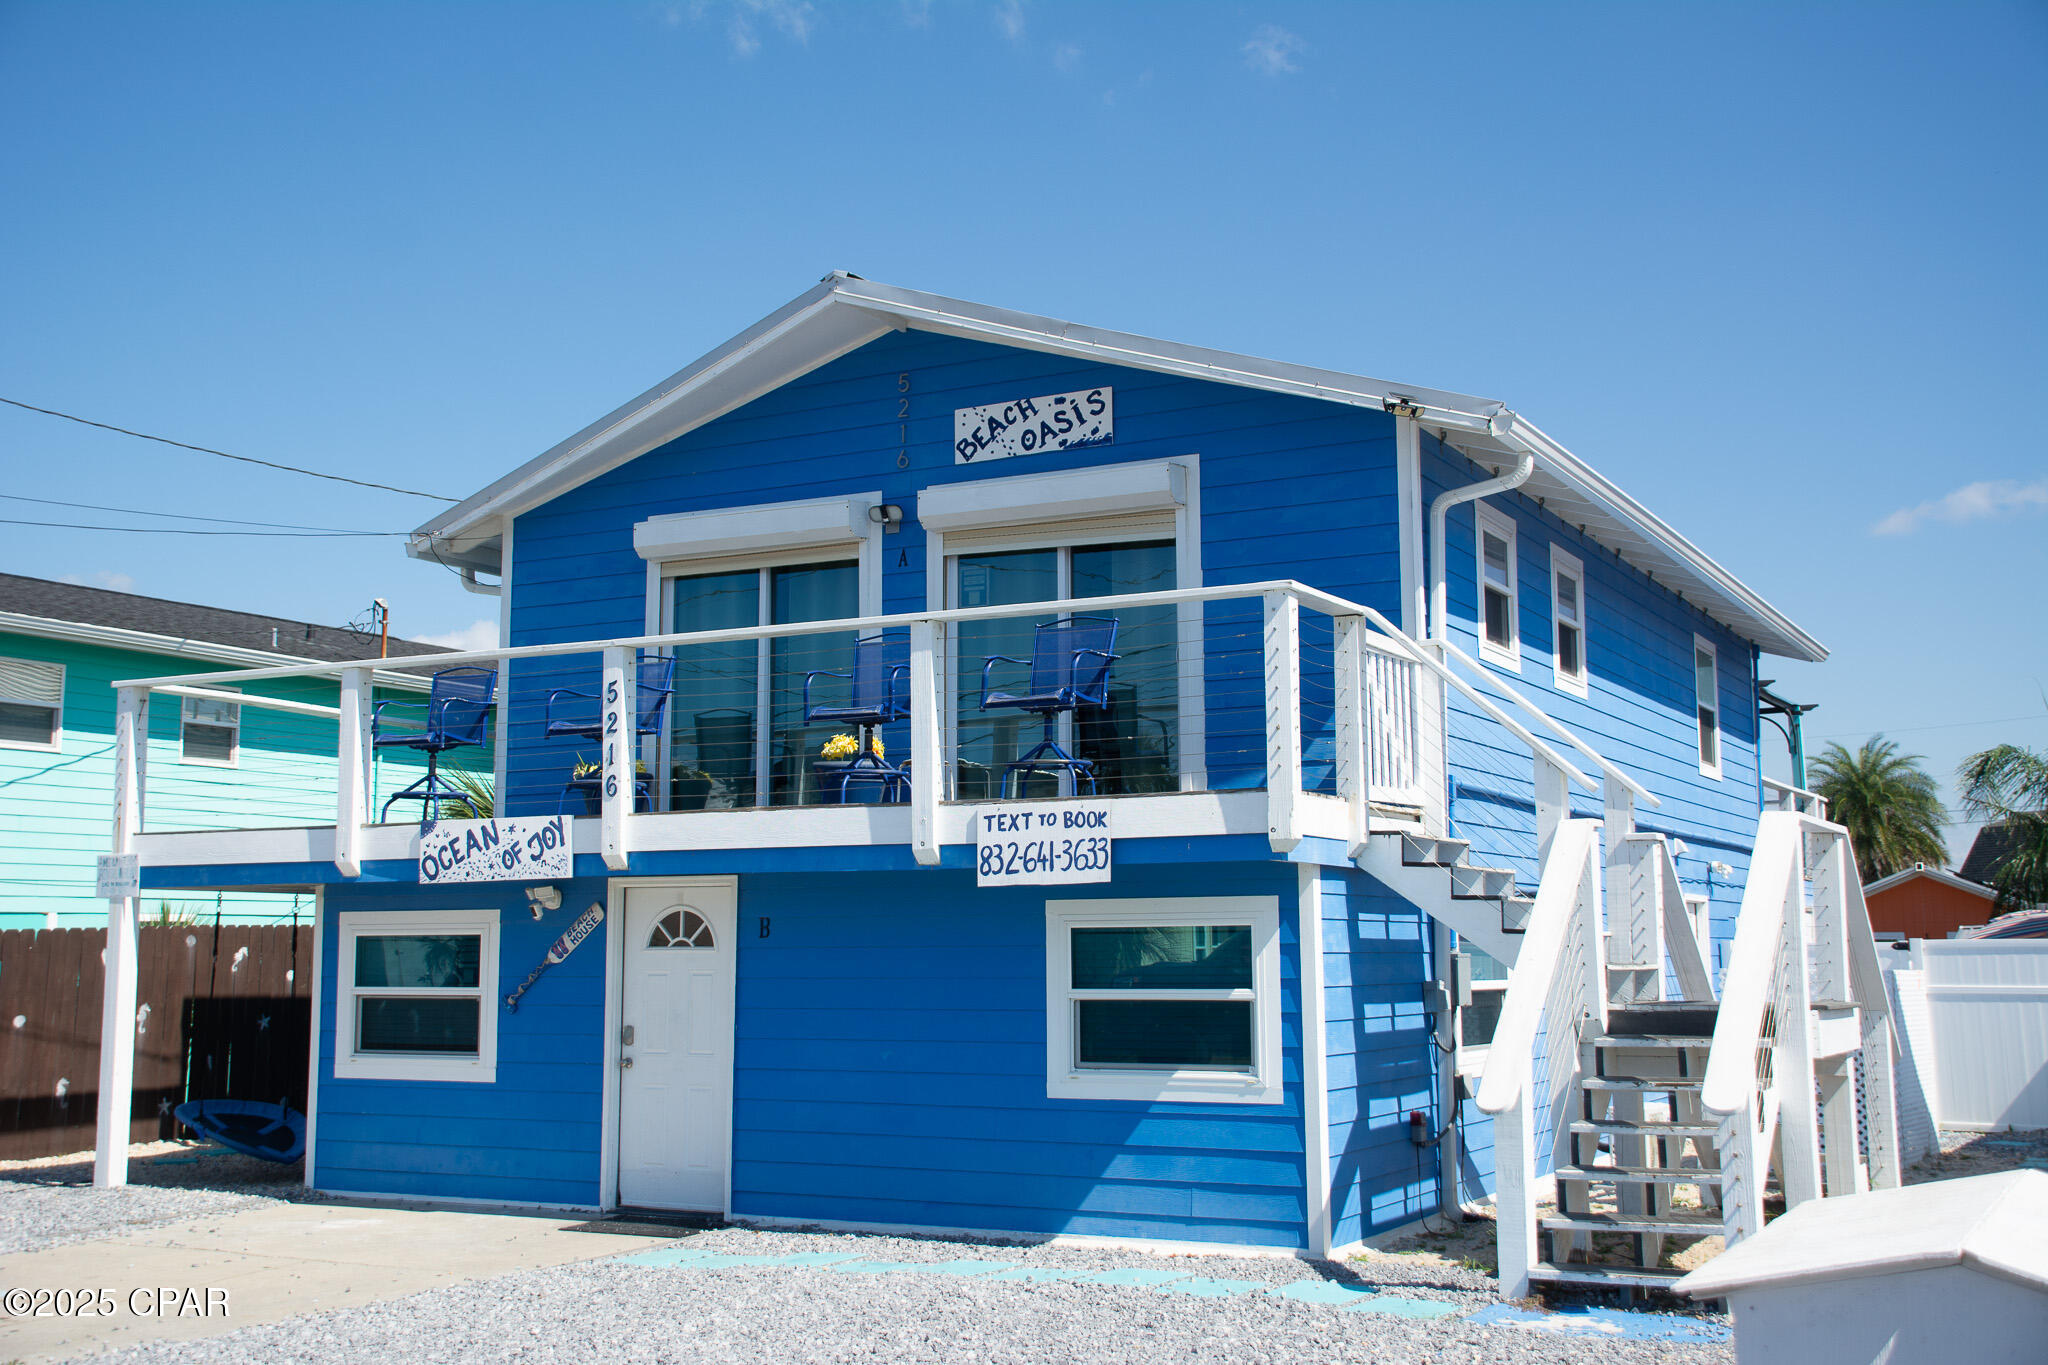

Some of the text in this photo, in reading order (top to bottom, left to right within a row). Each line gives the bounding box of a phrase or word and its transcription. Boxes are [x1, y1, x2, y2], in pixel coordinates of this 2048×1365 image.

[897, 373, 910, 469] 5216
[956, 398, 1039, 462] BEACH
[1021, 389, 1106, 451] OASIS
[898, 547, 908, 567] A
[606, 680, 618, 797] 5216
[502, 815, 565, 870] OF JOY
[983, 811, 1108, 832] TEXT TO BOOK
[421, 819, 500, 880] OCEAN
[980, 837, 1109, 876] 832-641-3633
[566, 907, 595, 938] BEACH
[569, 914, 600, 946] HOUSE
[758, 916, 771, 938] B
